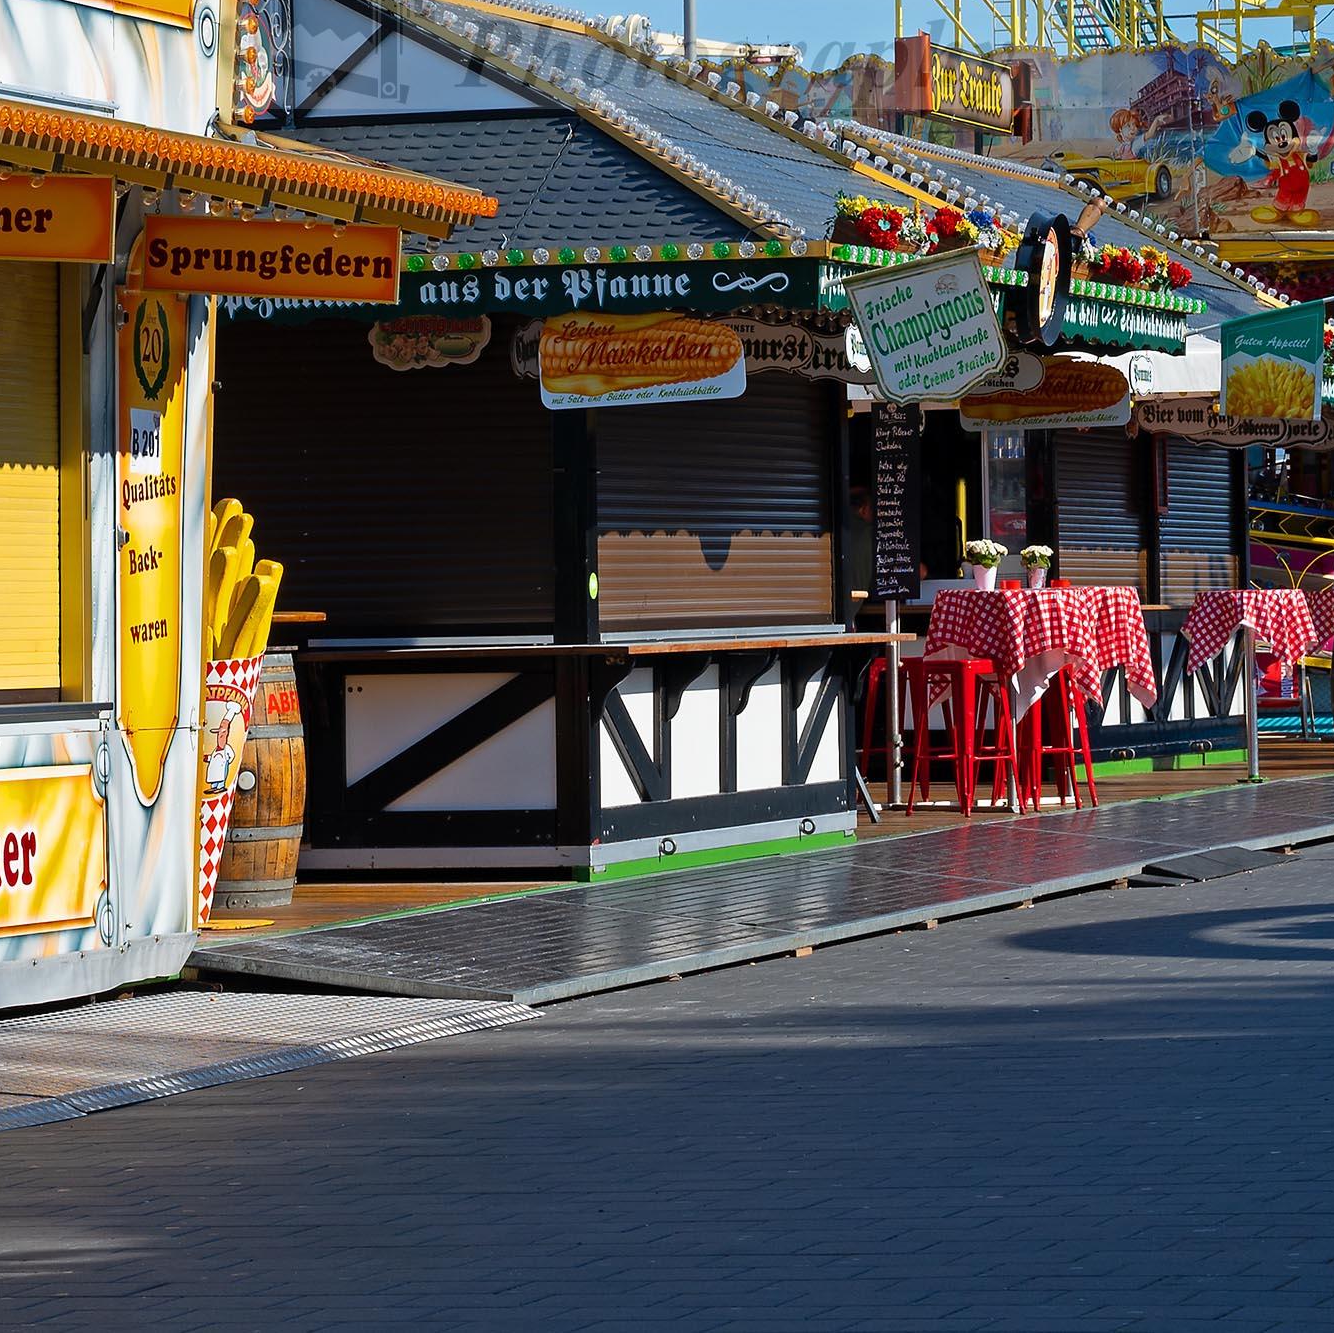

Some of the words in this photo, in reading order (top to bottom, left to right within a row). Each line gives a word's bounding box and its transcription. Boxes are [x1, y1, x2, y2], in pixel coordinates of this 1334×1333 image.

[931, 53, 957, 112] Zur
[959, 60, 1003, 117] Tränke
[147, 237, 395, 282] Sprungfedern
[420, 273, 480, 305] aus
[494, 270, 549, 302] der
[561, 268, 692, 309] Pfanne
[864, 285, 914, 321] Frische
[554, 319, 617, 344] Leckere
[870, 287, 986, 357] Champignons
[142, 327, 162, 364] 20
[566, 334, 713, 374] Maiskolben
[894, 357, 913, 374] mit
[914, 327, 990, 369] Knoblauchsoße
[1234, 334, 1264, 349] Guten
[1265, 334, 1312, 351] Appetit!
[897, 372, 921, 392] oder
[551, 397, 564, 406] mit
[1142, 405, 1174, 424] Bier
[1177, 408, 1204, 424] vom
[122, 471, 177, 511] Qualitäts
[128, 545, 164, 576] Back-
[130, 618, 168, 645] waren
